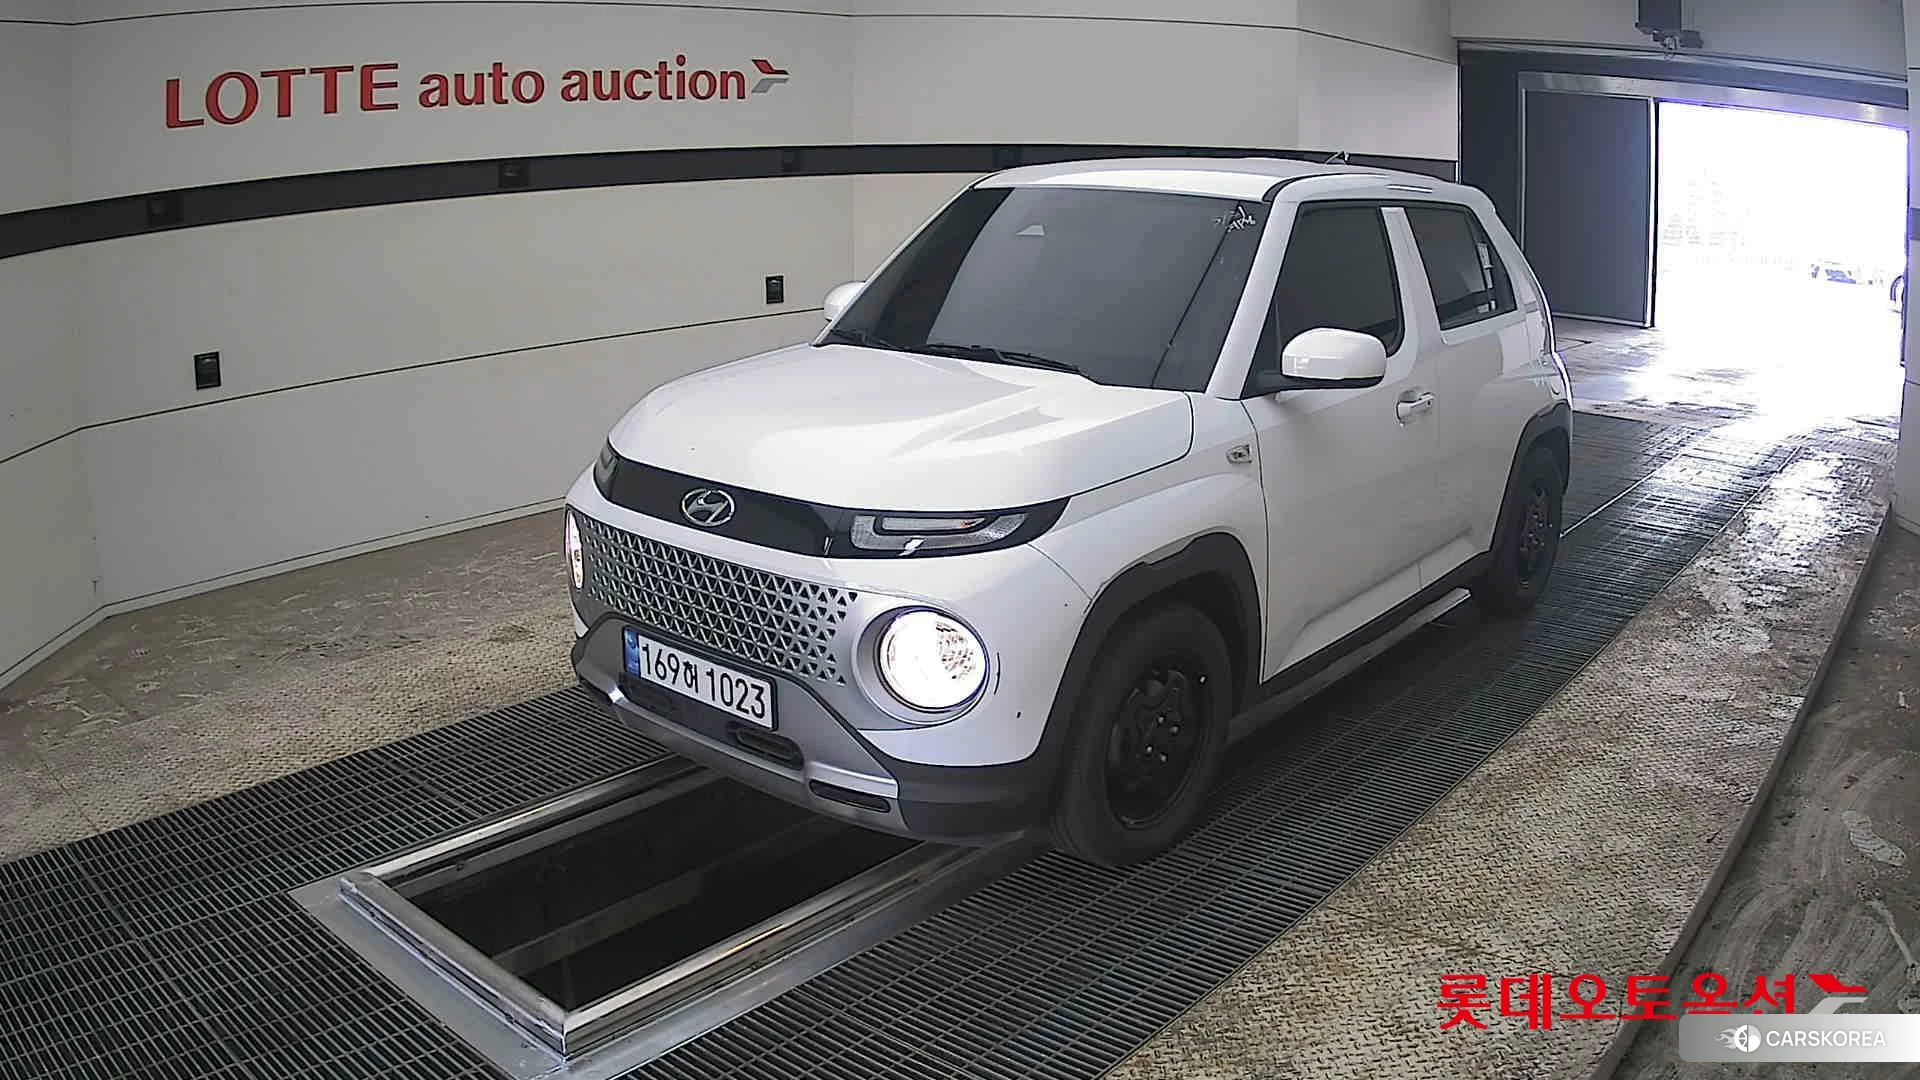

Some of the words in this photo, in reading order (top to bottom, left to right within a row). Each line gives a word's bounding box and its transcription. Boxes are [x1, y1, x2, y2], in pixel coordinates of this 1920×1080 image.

[165, 63, 399, 129] LOTTE
[419, 61, 544, 108] auto
[561, 54, 746, 102] auction
[706, 668, 766, 719] 1023
